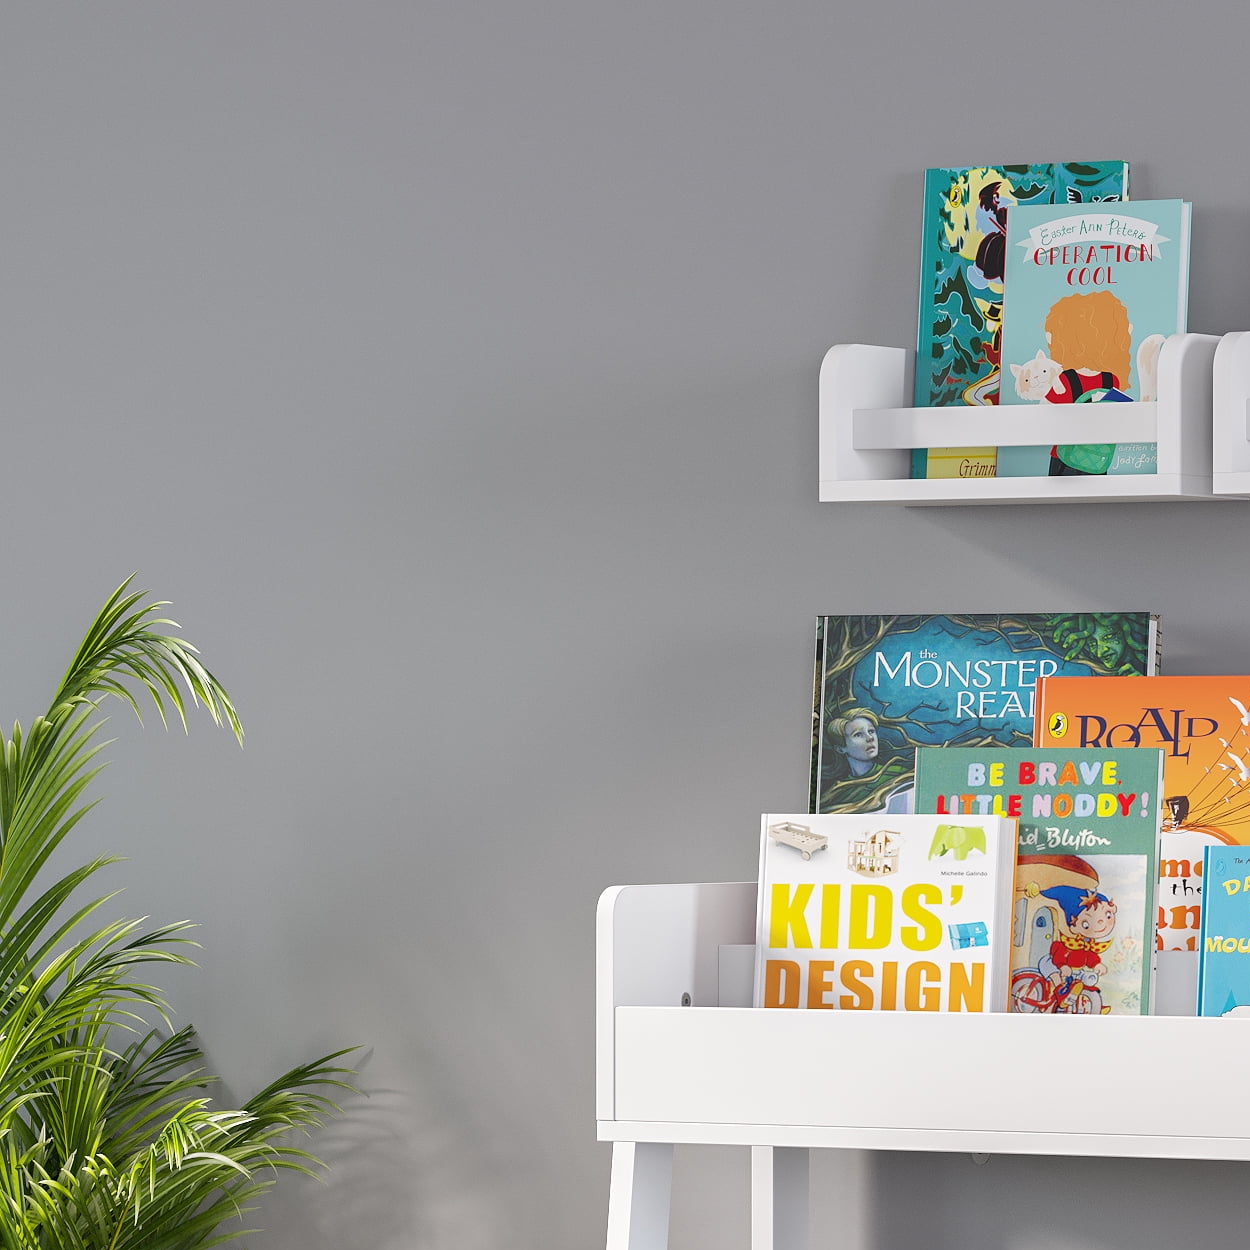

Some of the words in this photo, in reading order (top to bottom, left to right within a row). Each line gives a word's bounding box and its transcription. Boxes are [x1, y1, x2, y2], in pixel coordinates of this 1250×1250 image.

[1033, 244, 1153, 266] OPERATION
[1066, 266, 1118, 286] COOL
[918, 649, 937, 659] the
[873, 651, 1058, 688] MONSTER
[1075, 707, 1219, 765] ROALD
[968, 762, 1005, 787] BE
[936, 794, 1022, 818] LITTLE
[1032, 792, 1150, 818] NODDY!
[1045, 826, 1112, 850] Blyton
[764, 959, 986, 1012] DESIGN
